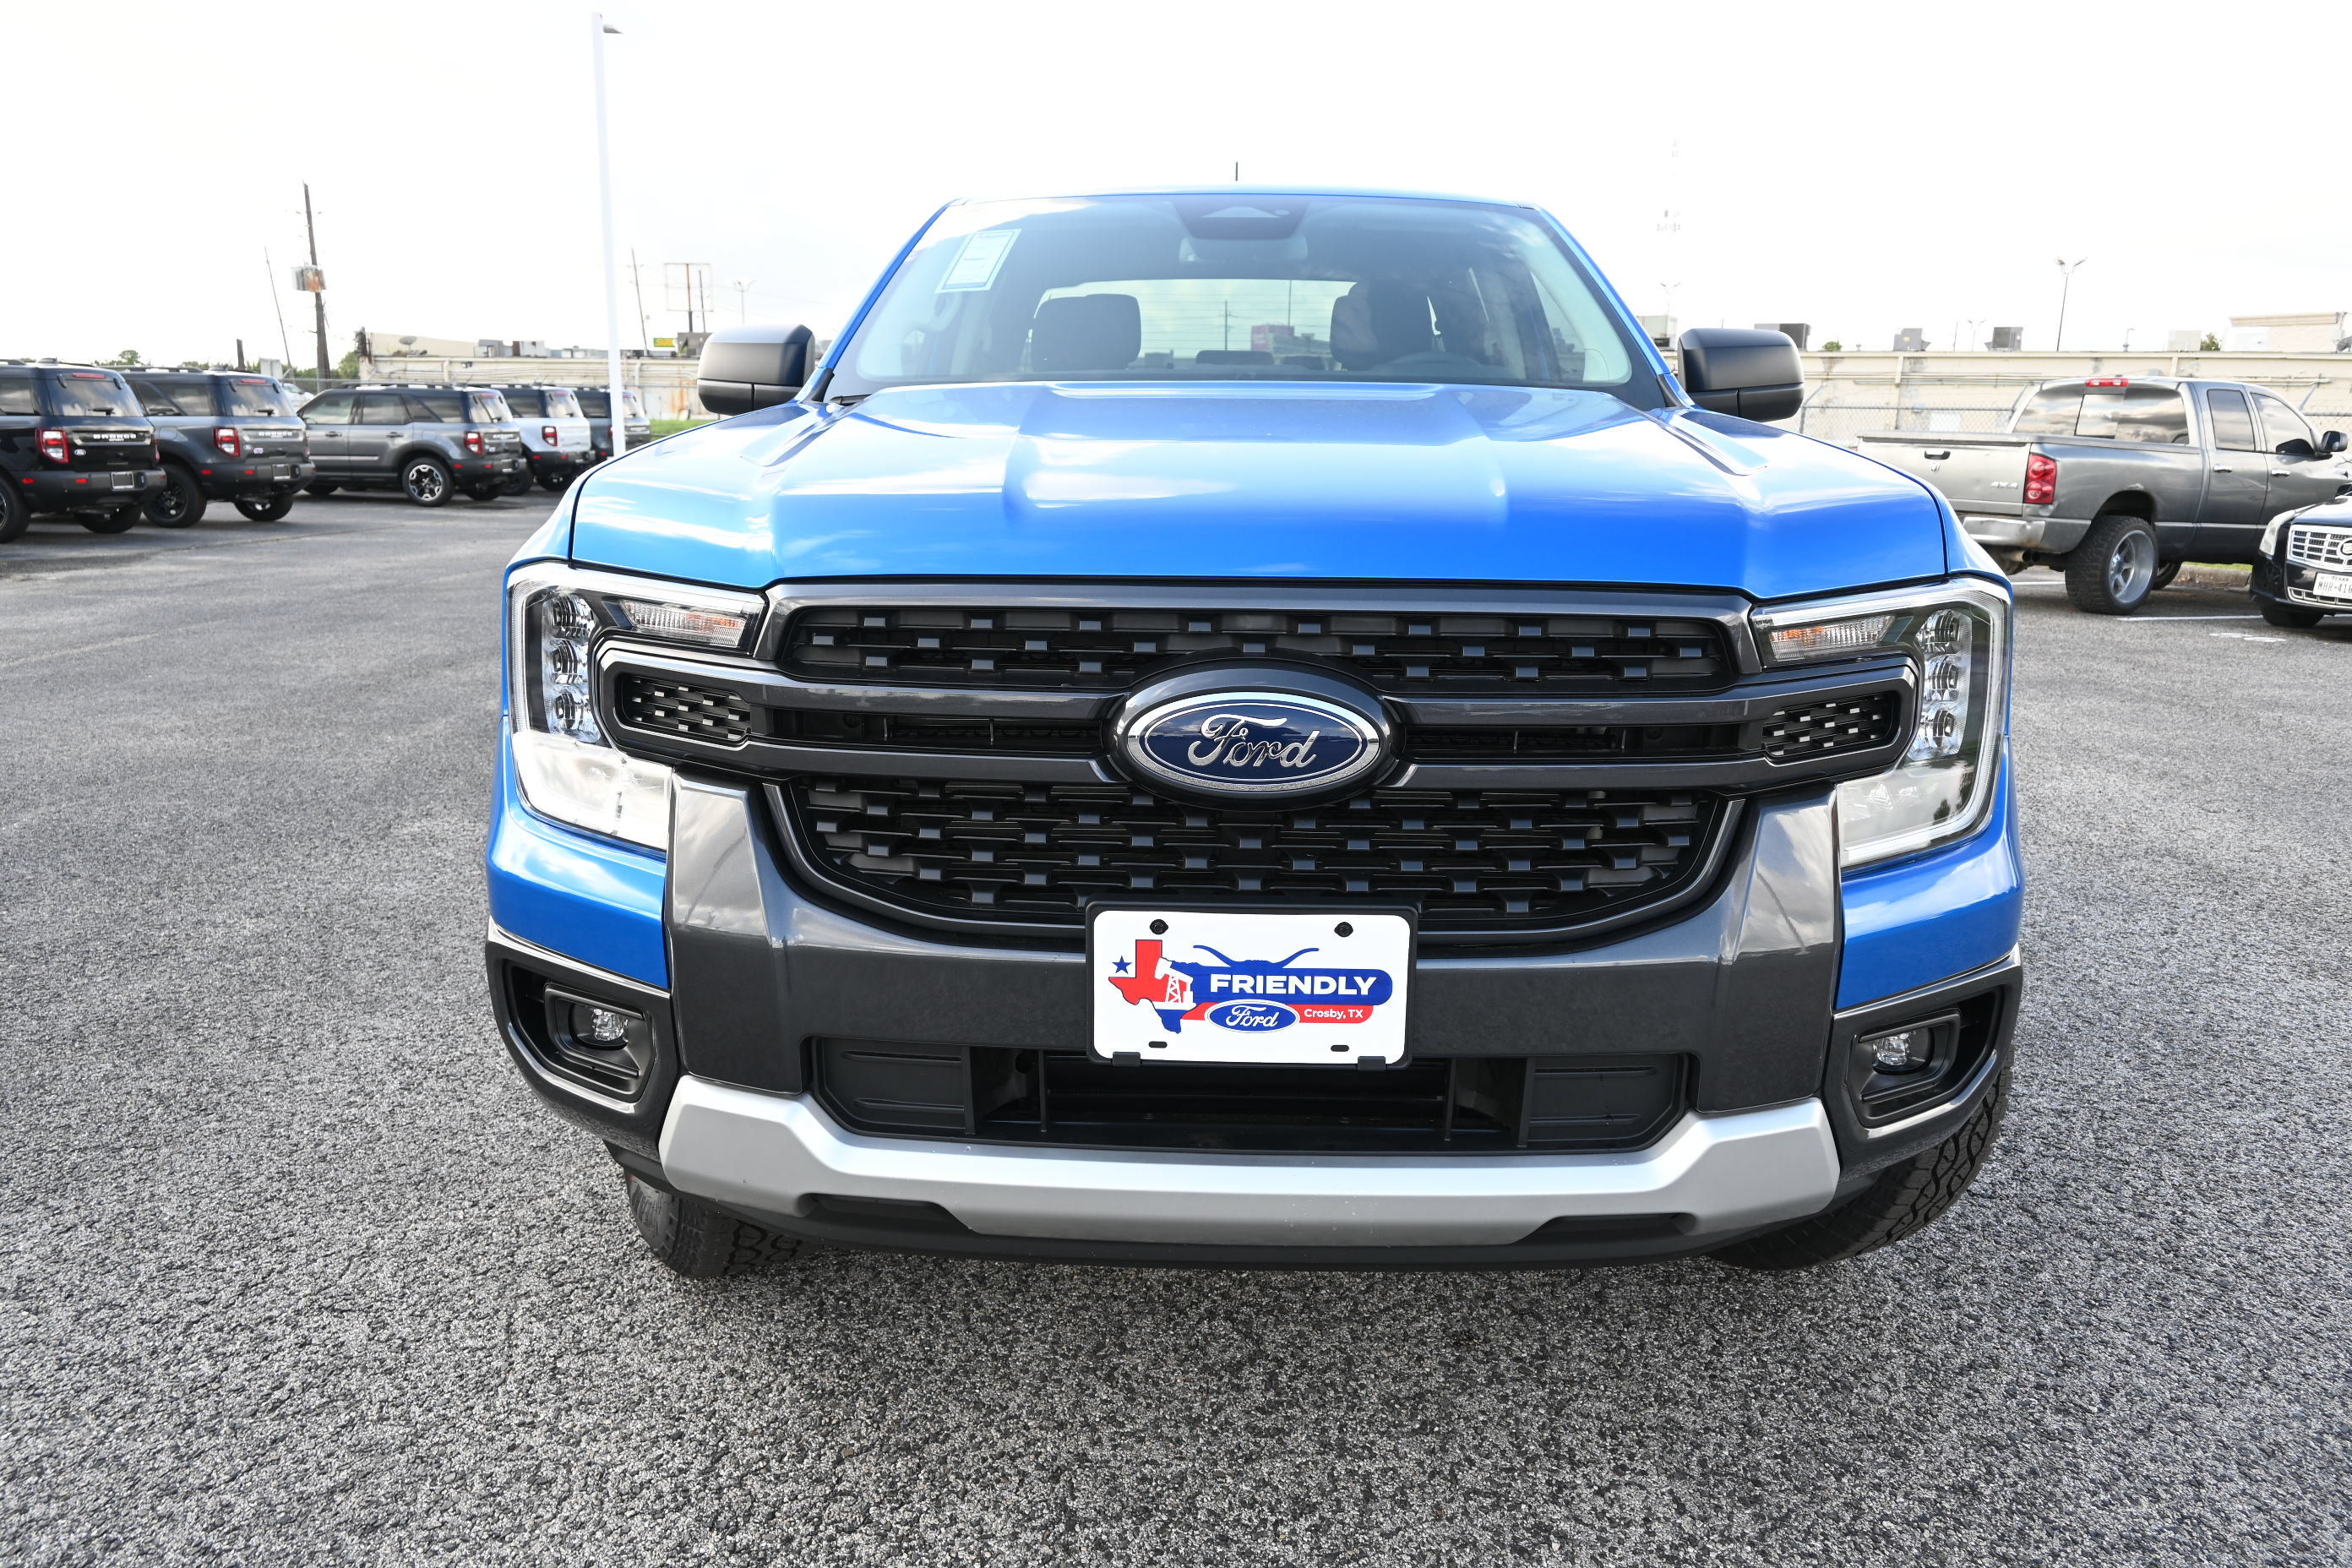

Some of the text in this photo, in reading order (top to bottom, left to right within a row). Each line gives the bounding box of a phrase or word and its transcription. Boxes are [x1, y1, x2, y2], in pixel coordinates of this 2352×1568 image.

[1188, 714, 1320, 768] Ford
[1210, 974, 1376, 995] FRIENDLY
[1225, 1005, 1281, 1027] Ford
[1304, 1008, 1364, 1019] Crosby, TX
